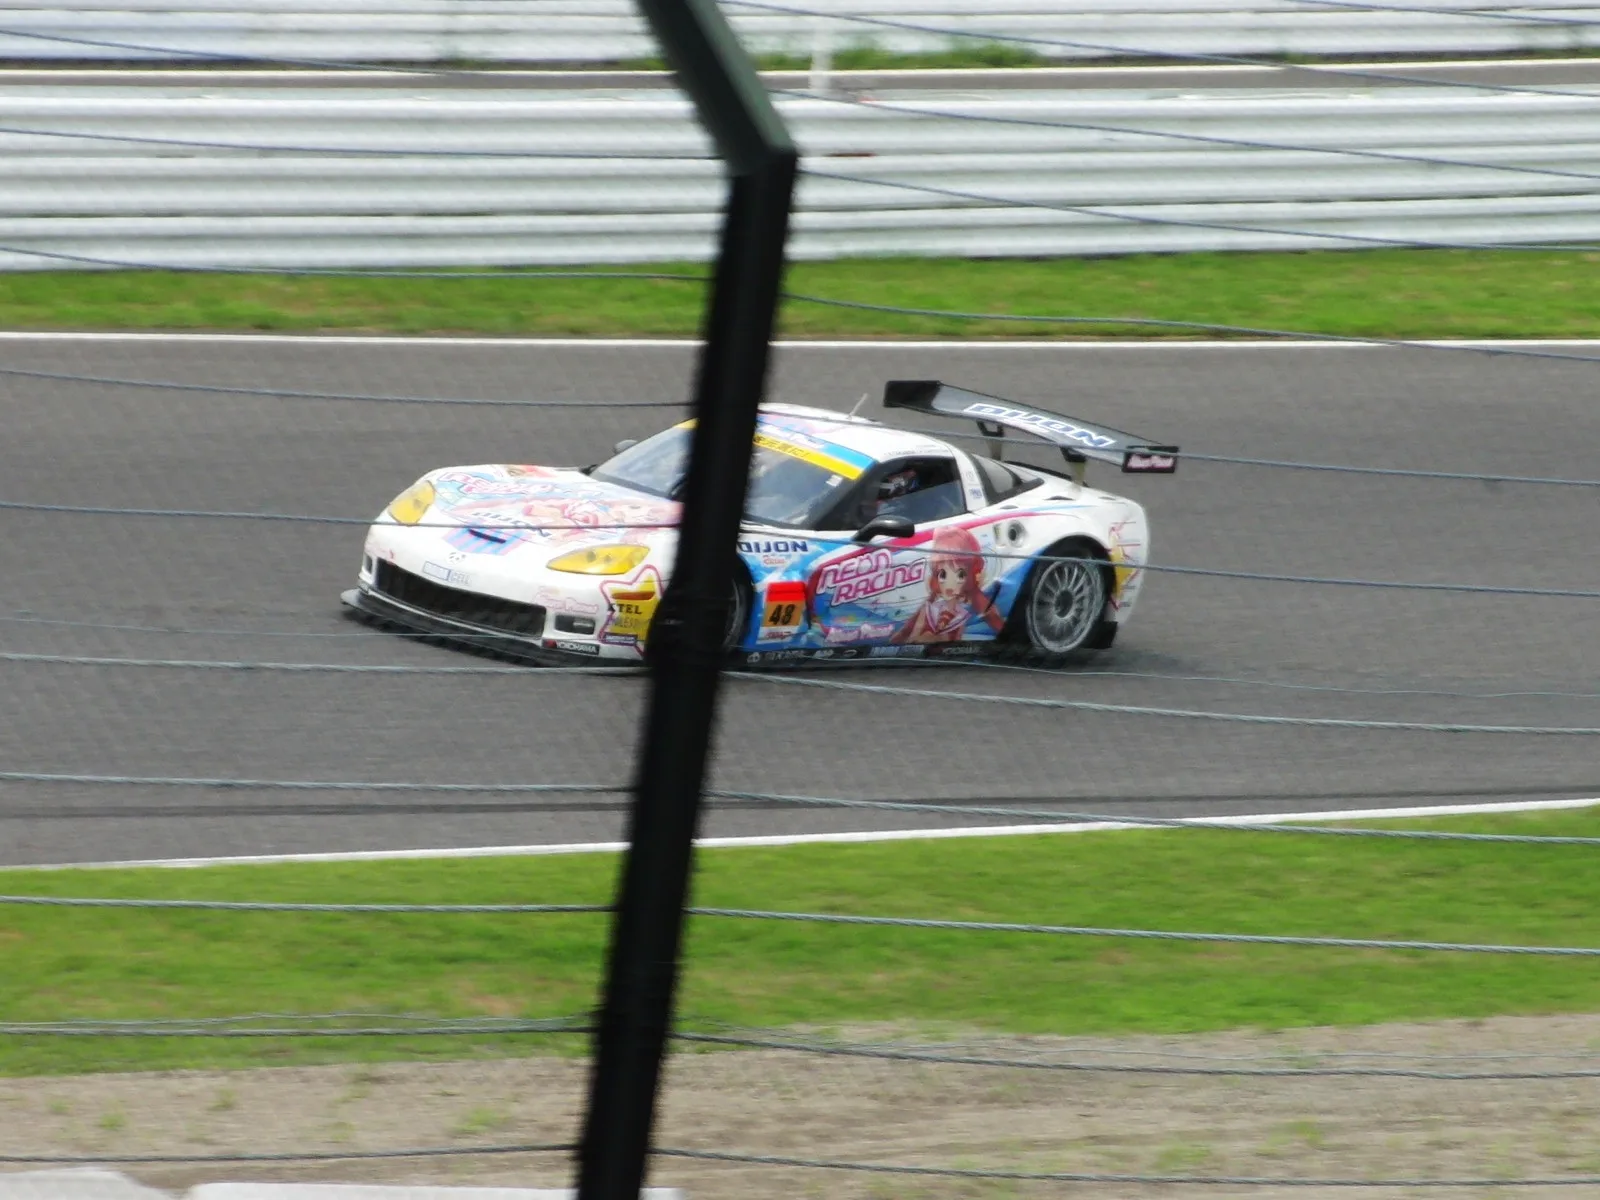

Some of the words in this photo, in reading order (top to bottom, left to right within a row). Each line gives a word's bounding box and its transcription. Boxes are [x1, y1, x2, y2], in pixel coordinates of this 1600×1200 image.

[963, 403, 1117, 447] DIJON
[739, 541, 808, 553] DIJON
[830, 558, 926, 607] RACING
[768, 603, 796, 625] 48
[557, 641, 598, 654] YOKOHAMA
